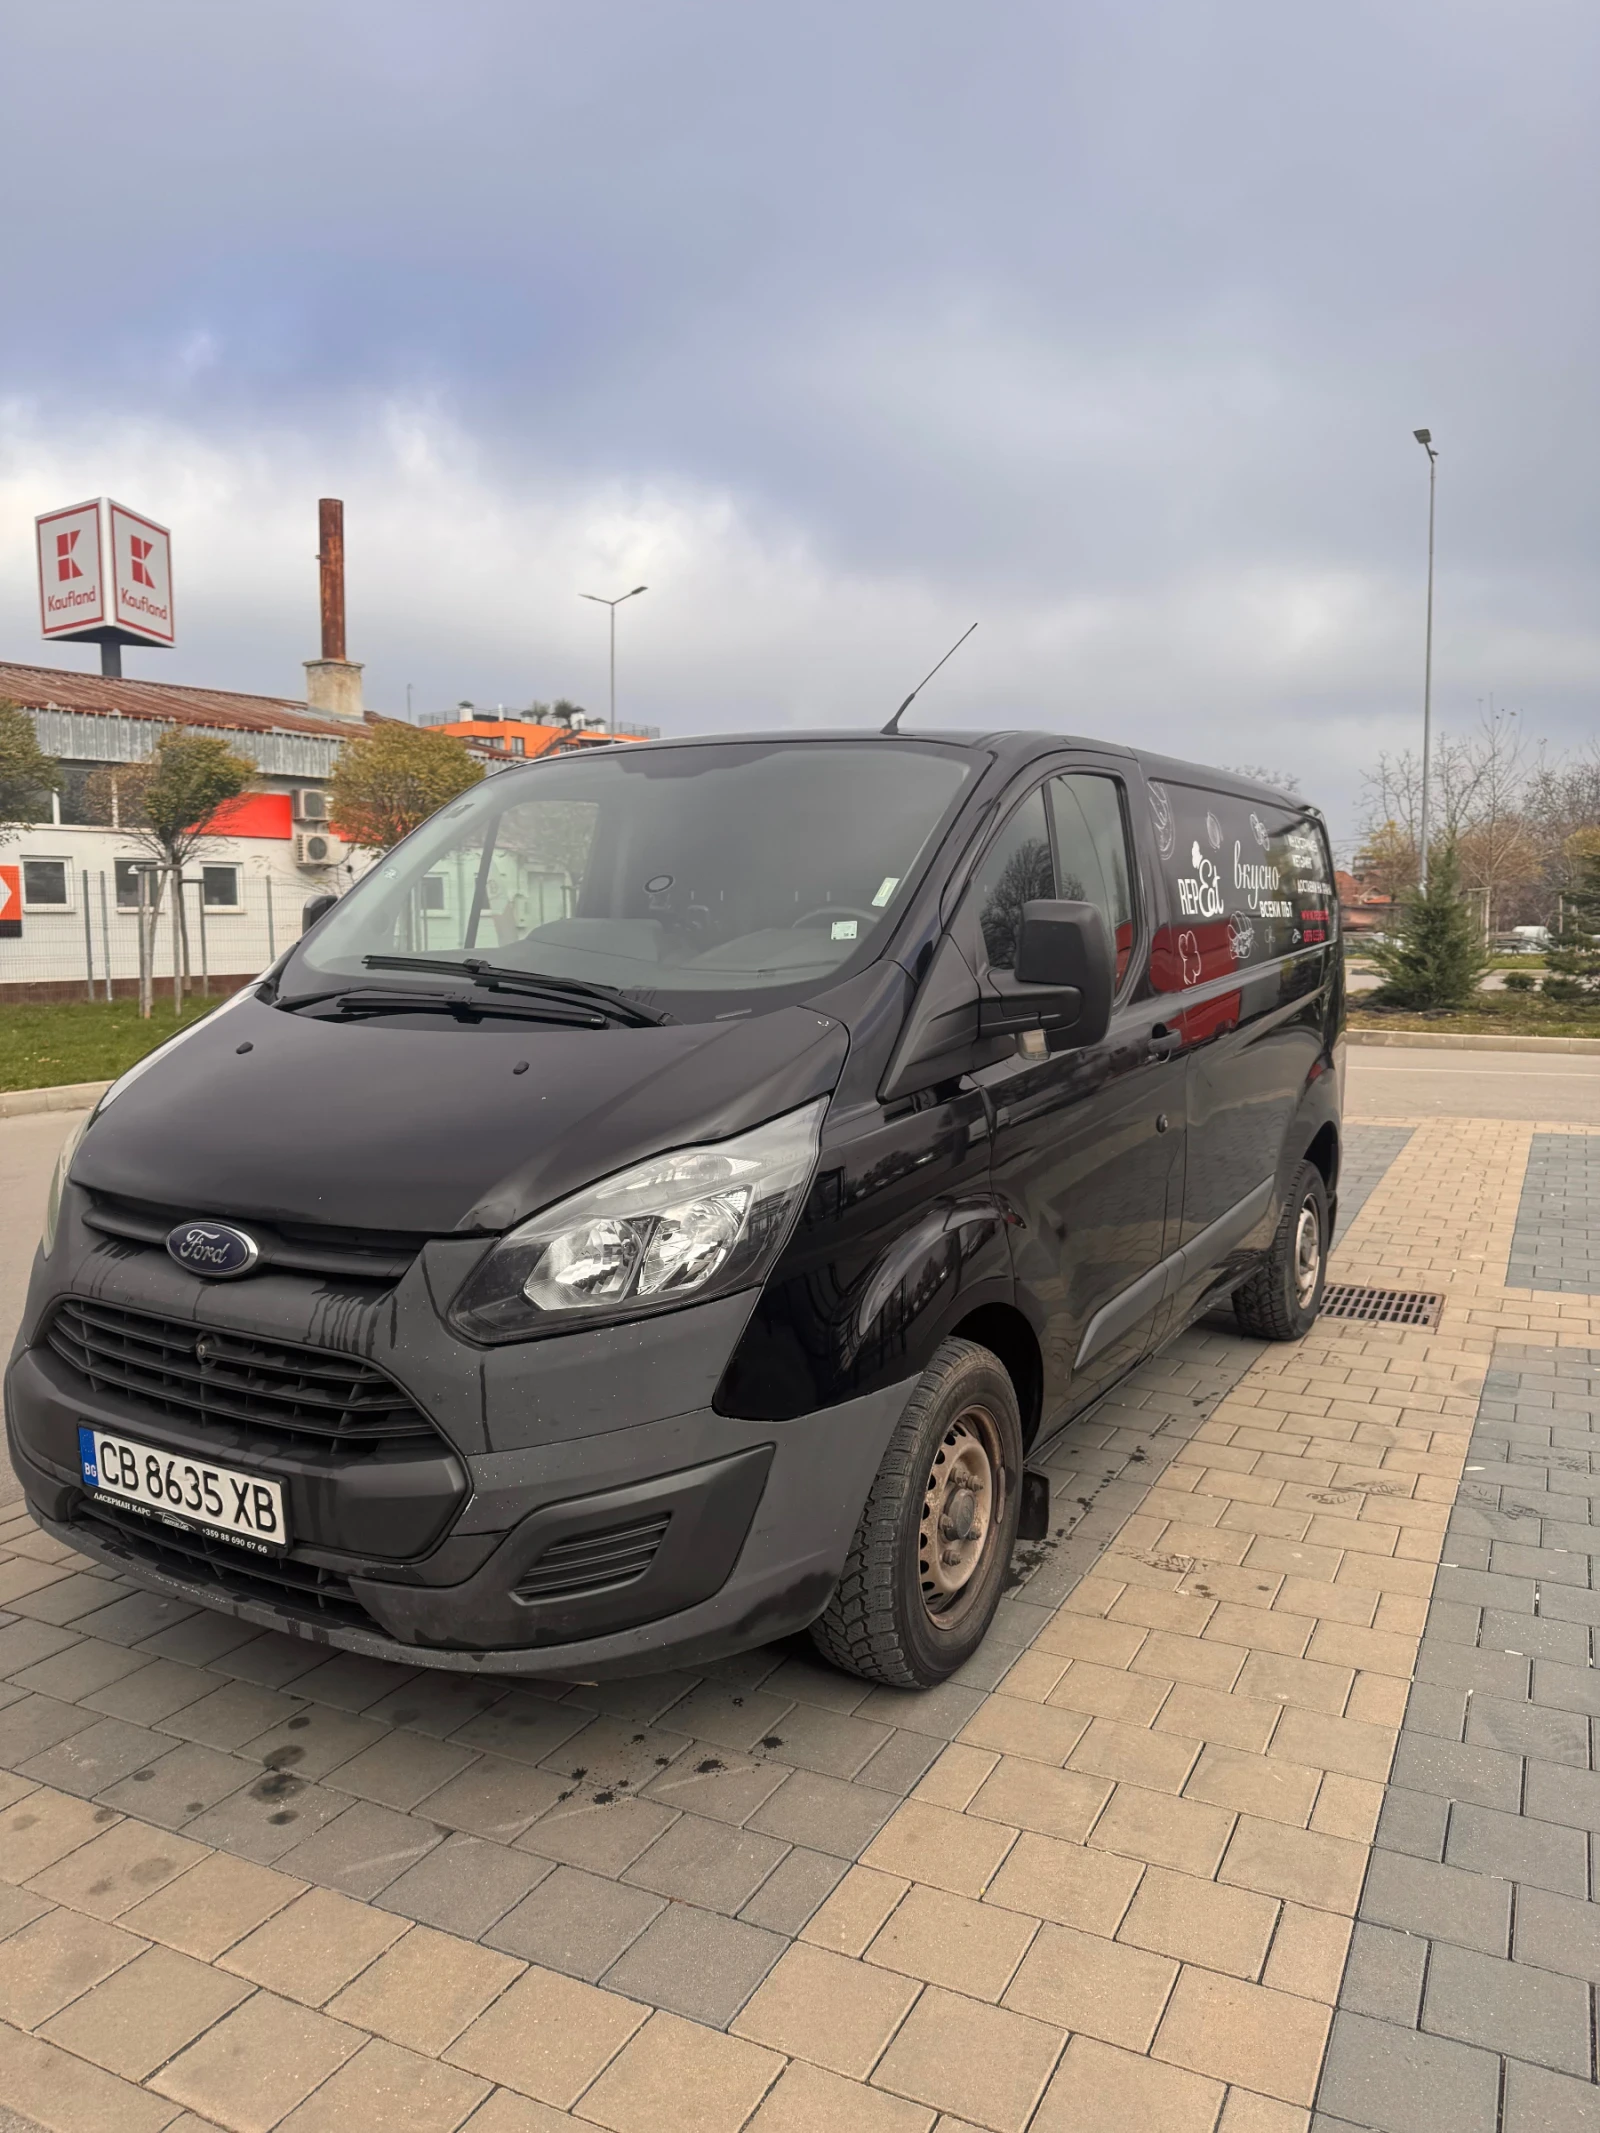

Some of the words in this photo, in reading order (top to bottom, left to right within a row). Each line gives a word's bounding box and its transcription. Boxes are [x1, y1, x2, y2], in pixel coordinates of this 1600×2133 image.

[48, 585, 96, 612] Kaufland
[121, 587, 168, 620] Kaufland
[1260, 901, 1281, 917] ВСЕКИ
[1281, 901, 1293, 917] ПЪТ
[180, 1229, 230, 1263] Ford
[84, 1462, 97, 1478] BG
[145, 1454, 223, 1517] 8635
[131, 1504, 151, 1517] КАРС
[202, 1528, 219, 1539] +359
[220, 1533, 230, 1542] 88
[231, 1536, 245, 1547] 690
[257, 1544, 268, 1554] 66
